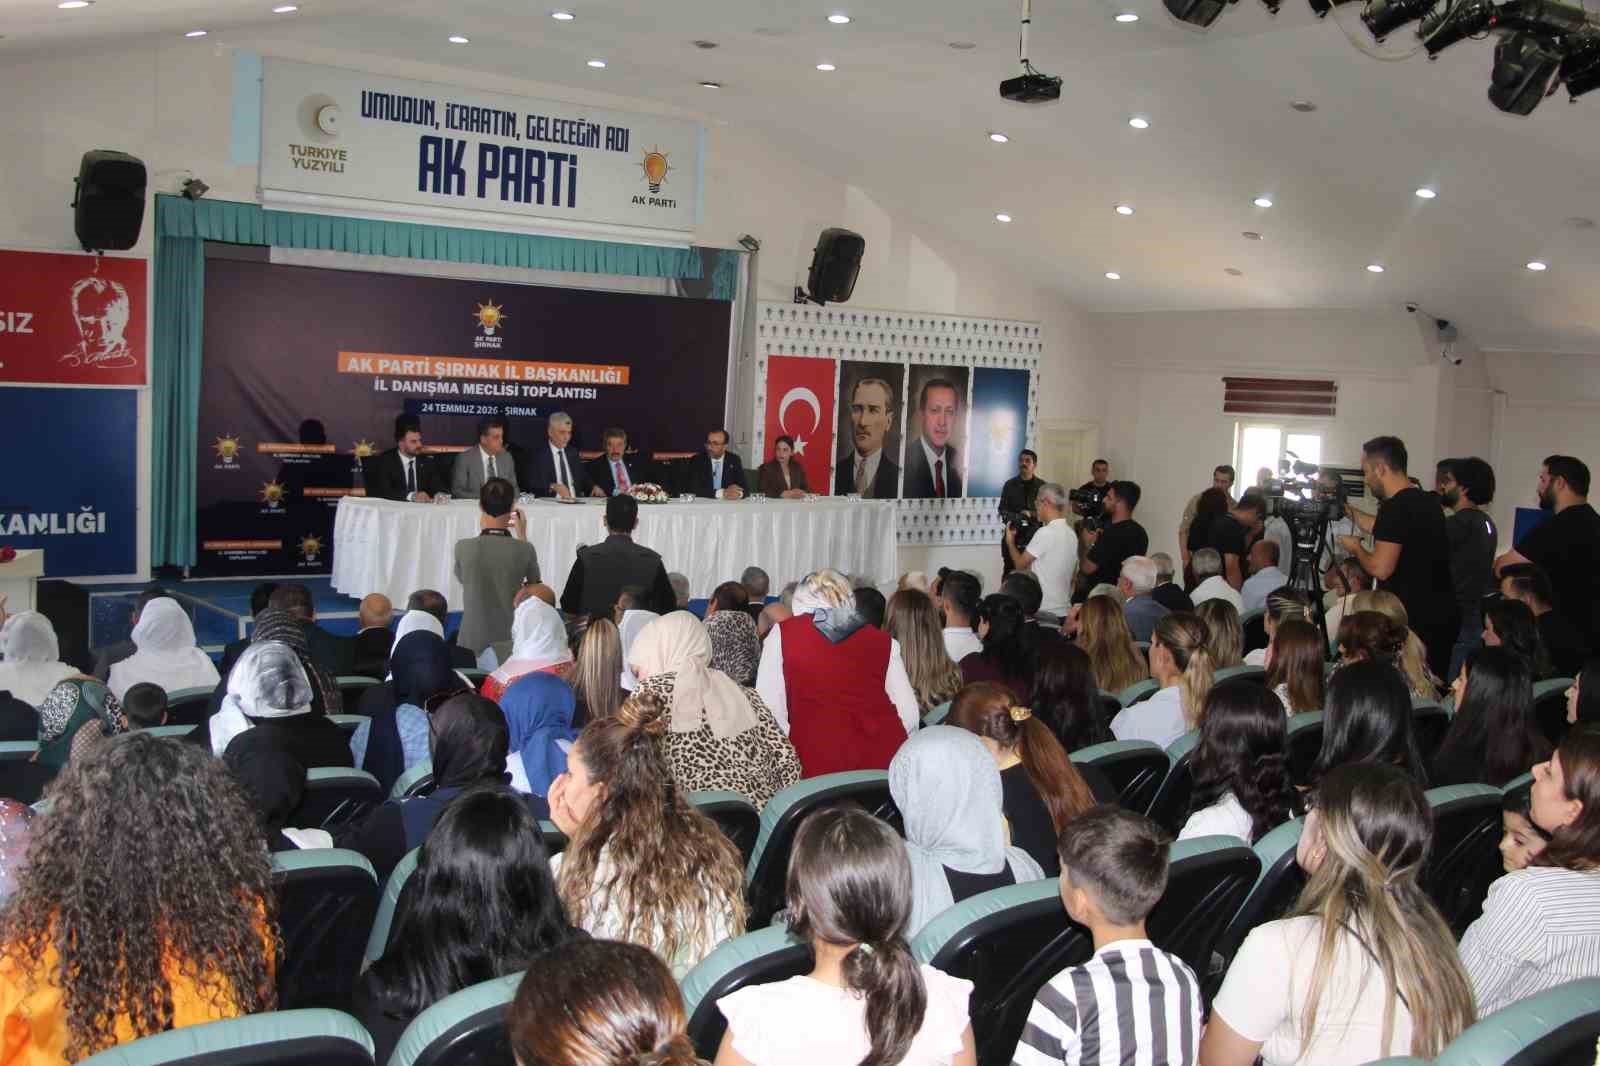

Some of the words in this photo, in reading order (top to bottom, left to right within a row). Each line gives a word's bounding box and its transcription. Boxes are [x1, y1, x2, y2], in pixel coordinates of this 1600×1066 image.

[361, 90, 440, 130] UMUDUN,
[445, 102, 520, 141] İCRAATIN,
[526, 114, 601, 149] GELECEĞİN
[605, 125, 630, 153] ADI
[418, 135, 467, 197] AK
[477, 142, 578, 208] PARTİ
[631, 195, 646, 205] AK
[347, 357, 373, 374] AK
[379, 356, 432, 376] PARTİ
[434, 360, 501, 380] ŞIRNAK
[504, 361, 521, 381] İL
[524, 365, 622, 386] BAŞKANLIĞI
[373, 375, 389, 392] İL
[391, 379, 460, 397] DANIŞMA
[463, 382, 519, 397] MECLİSİ
[521, 385, 597, 400] TOPLANTISI
[421, 402, 434, 413] 24
[435, 403, 475, 415] TEMMUZ
[476, 405, 498, 416] 2026
